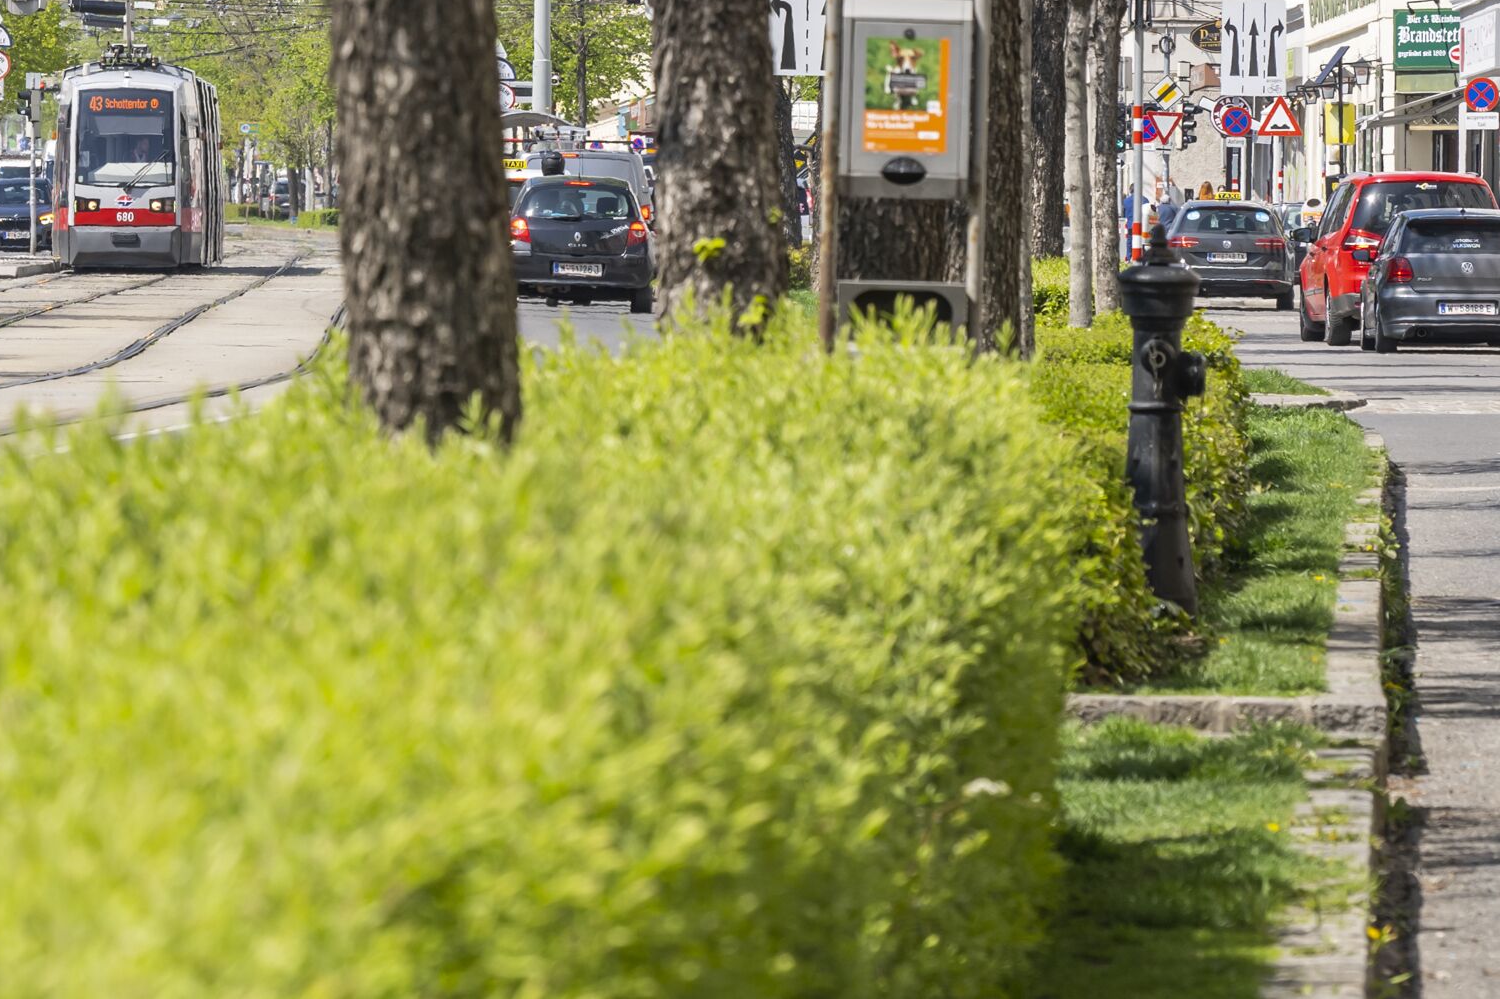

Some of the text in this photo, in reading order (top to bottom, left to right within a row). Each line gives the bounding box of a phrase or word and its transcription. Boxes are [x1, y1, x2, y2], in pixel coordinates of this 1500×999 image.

[89, 96, 103, 112] 43
[104, 98, 149, 110] Schottentor
[505, 160, 524, 168] TAXI
[116, 211, 134, 222] 680
